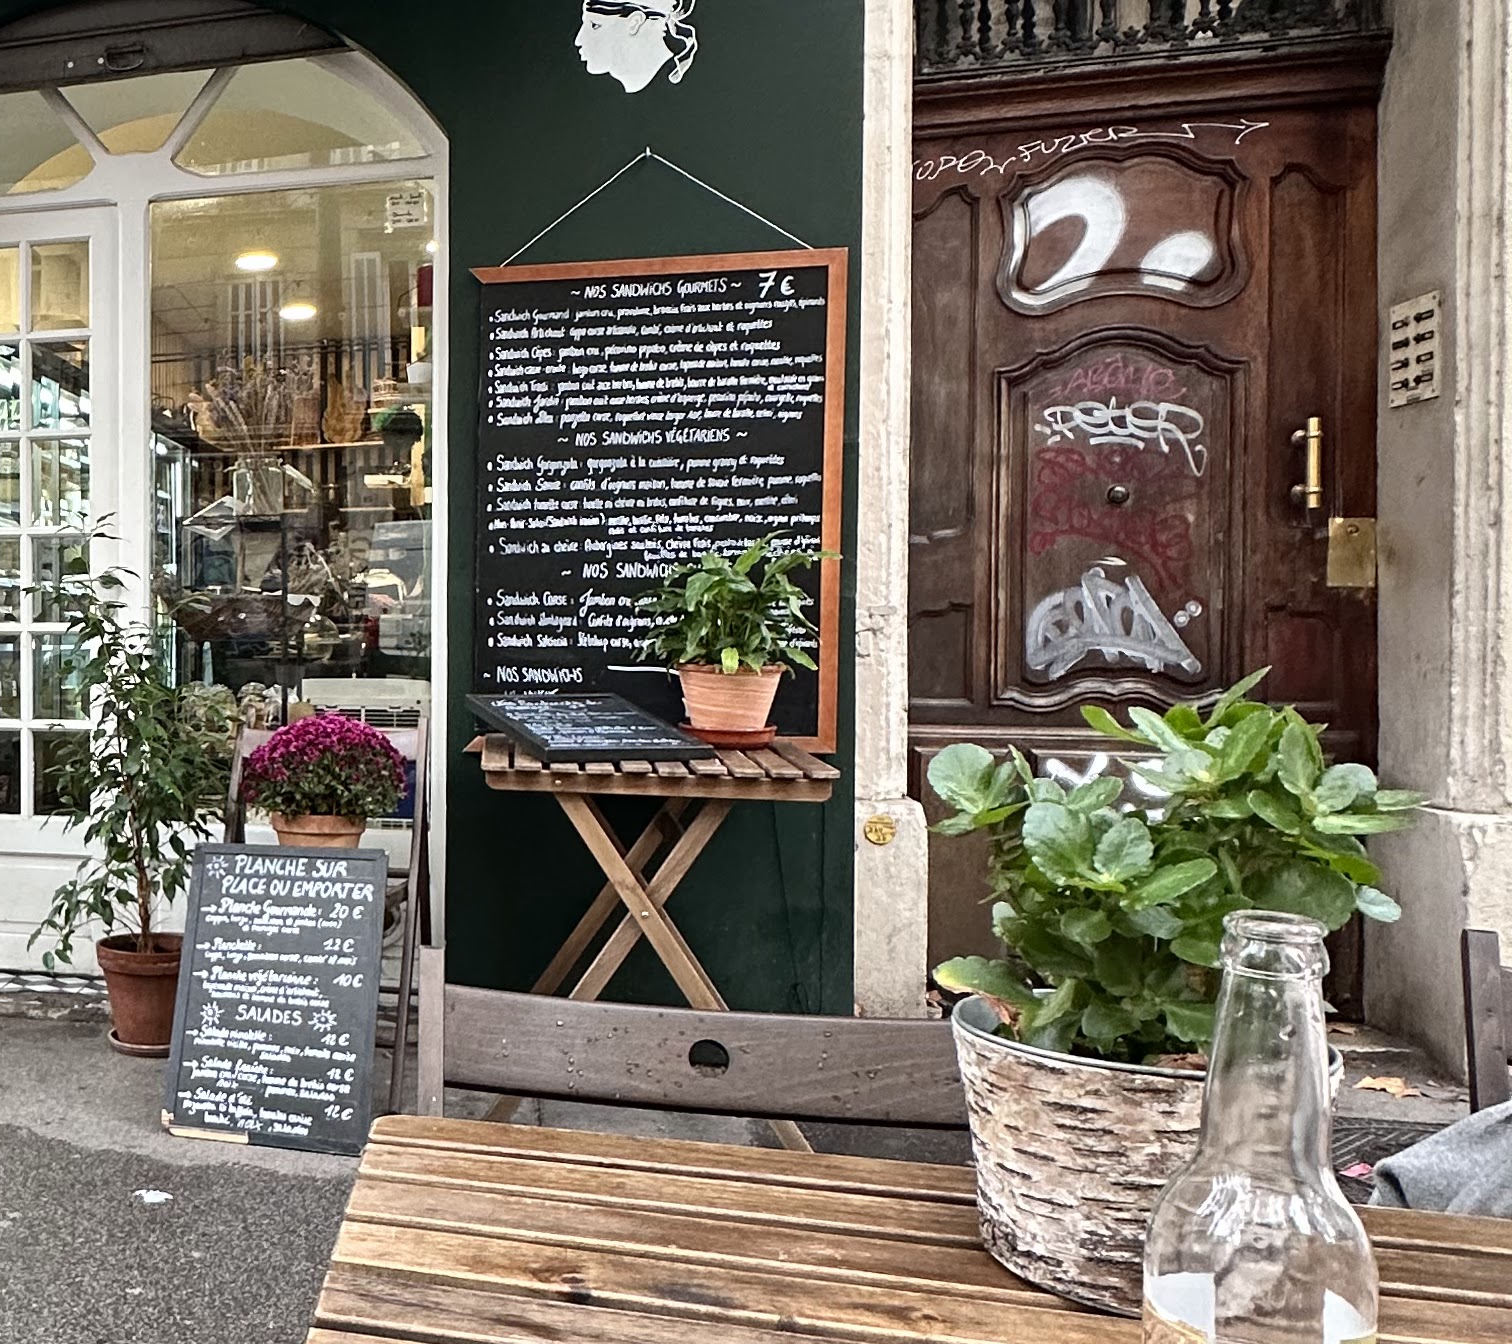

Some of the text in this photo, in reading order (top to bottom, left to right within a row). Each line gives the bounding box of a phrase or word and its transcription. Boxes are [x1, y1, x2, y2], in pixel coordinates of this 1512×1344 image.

[584, 284, 607, 299] NOS
[575, 432, 597, 446] NOS
[582, 562, 608, 578] NOS
[496, 588, 540, 606] Sandwich
[496, 666, 519, 682] NOS
[235, 854, 348, 878] PLANCHE SUR
[221, 875, 374, 902] PLACE OU EMPORTER
[218, 897, 262, 914] Planche
[235, 1004, 303, 1026] SALADES
